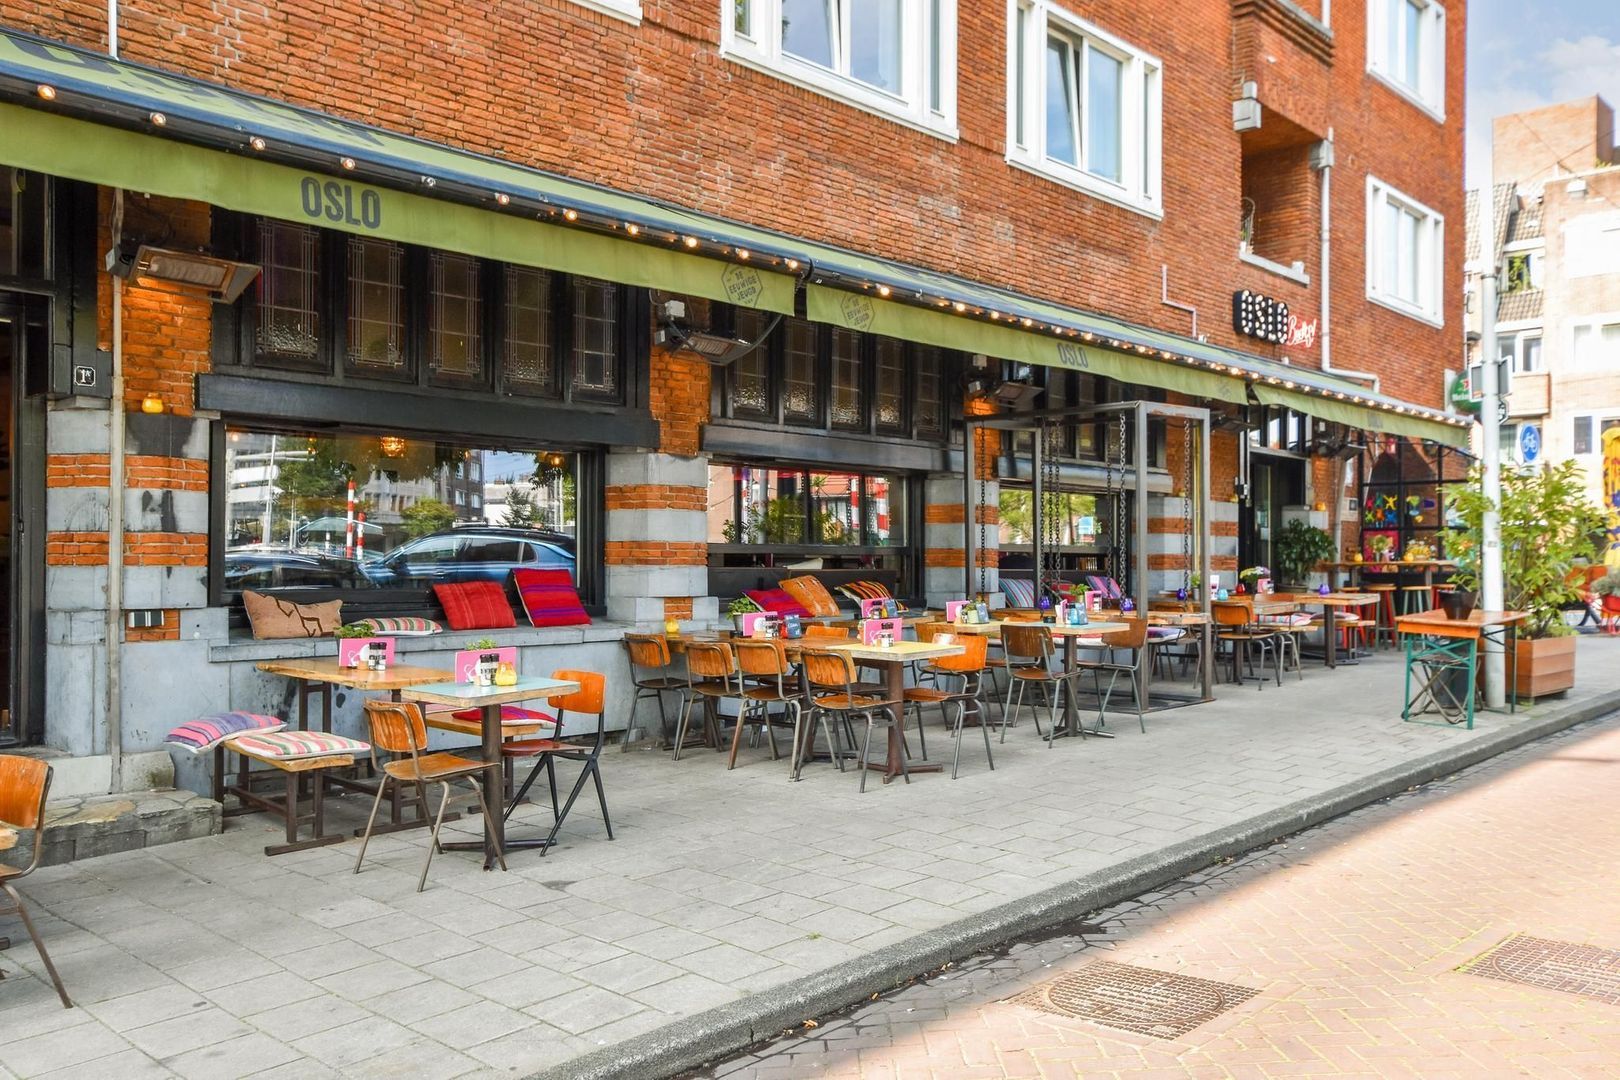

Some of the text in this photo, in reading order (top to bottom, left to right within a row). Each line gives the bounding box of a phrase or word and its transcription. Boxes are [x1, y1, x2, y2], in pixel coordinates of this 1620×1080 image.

[301, 176, 381, 230] OSLO
[1232, 288, 1289, 345] OSLO
[1056, 342, 1089, 369] OSLO
